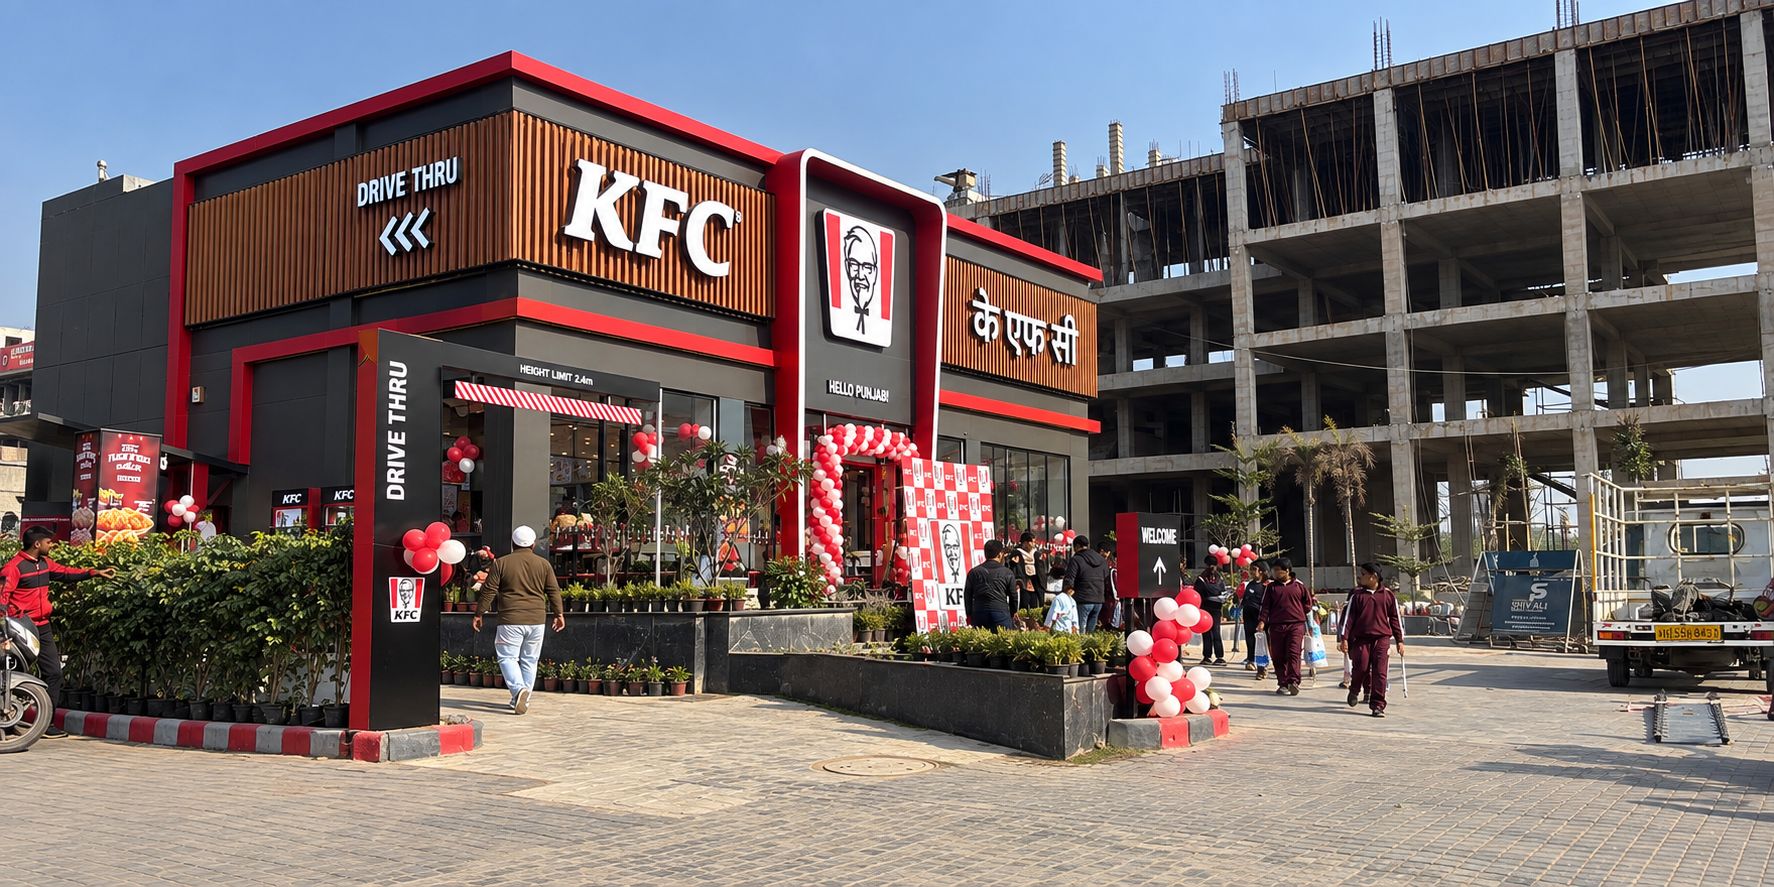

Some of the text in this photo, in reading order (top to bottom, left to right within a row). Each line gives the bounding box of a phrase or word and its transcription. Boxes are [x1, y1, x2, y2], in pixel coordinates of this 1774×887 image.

[357, 156, 458, 207] DRIVE THRU
[972, 287, 1079, 366] के एफ सी
[520, 364, 550, 378] HEIGHT
[551, 369, 573, 382] LIMIT
[828, 379, 889, 403] HELLO PUNJAB!
[386, 360, 408, 501] DRIVE THRU
[282, 493, 302, 504] KFC
[333, 489, 355, 501] KFC
[1141, 526, 1177, 545] WELCOME
[945, 587, 963, 606] KF
[394, 610, 418, 620] KFC
